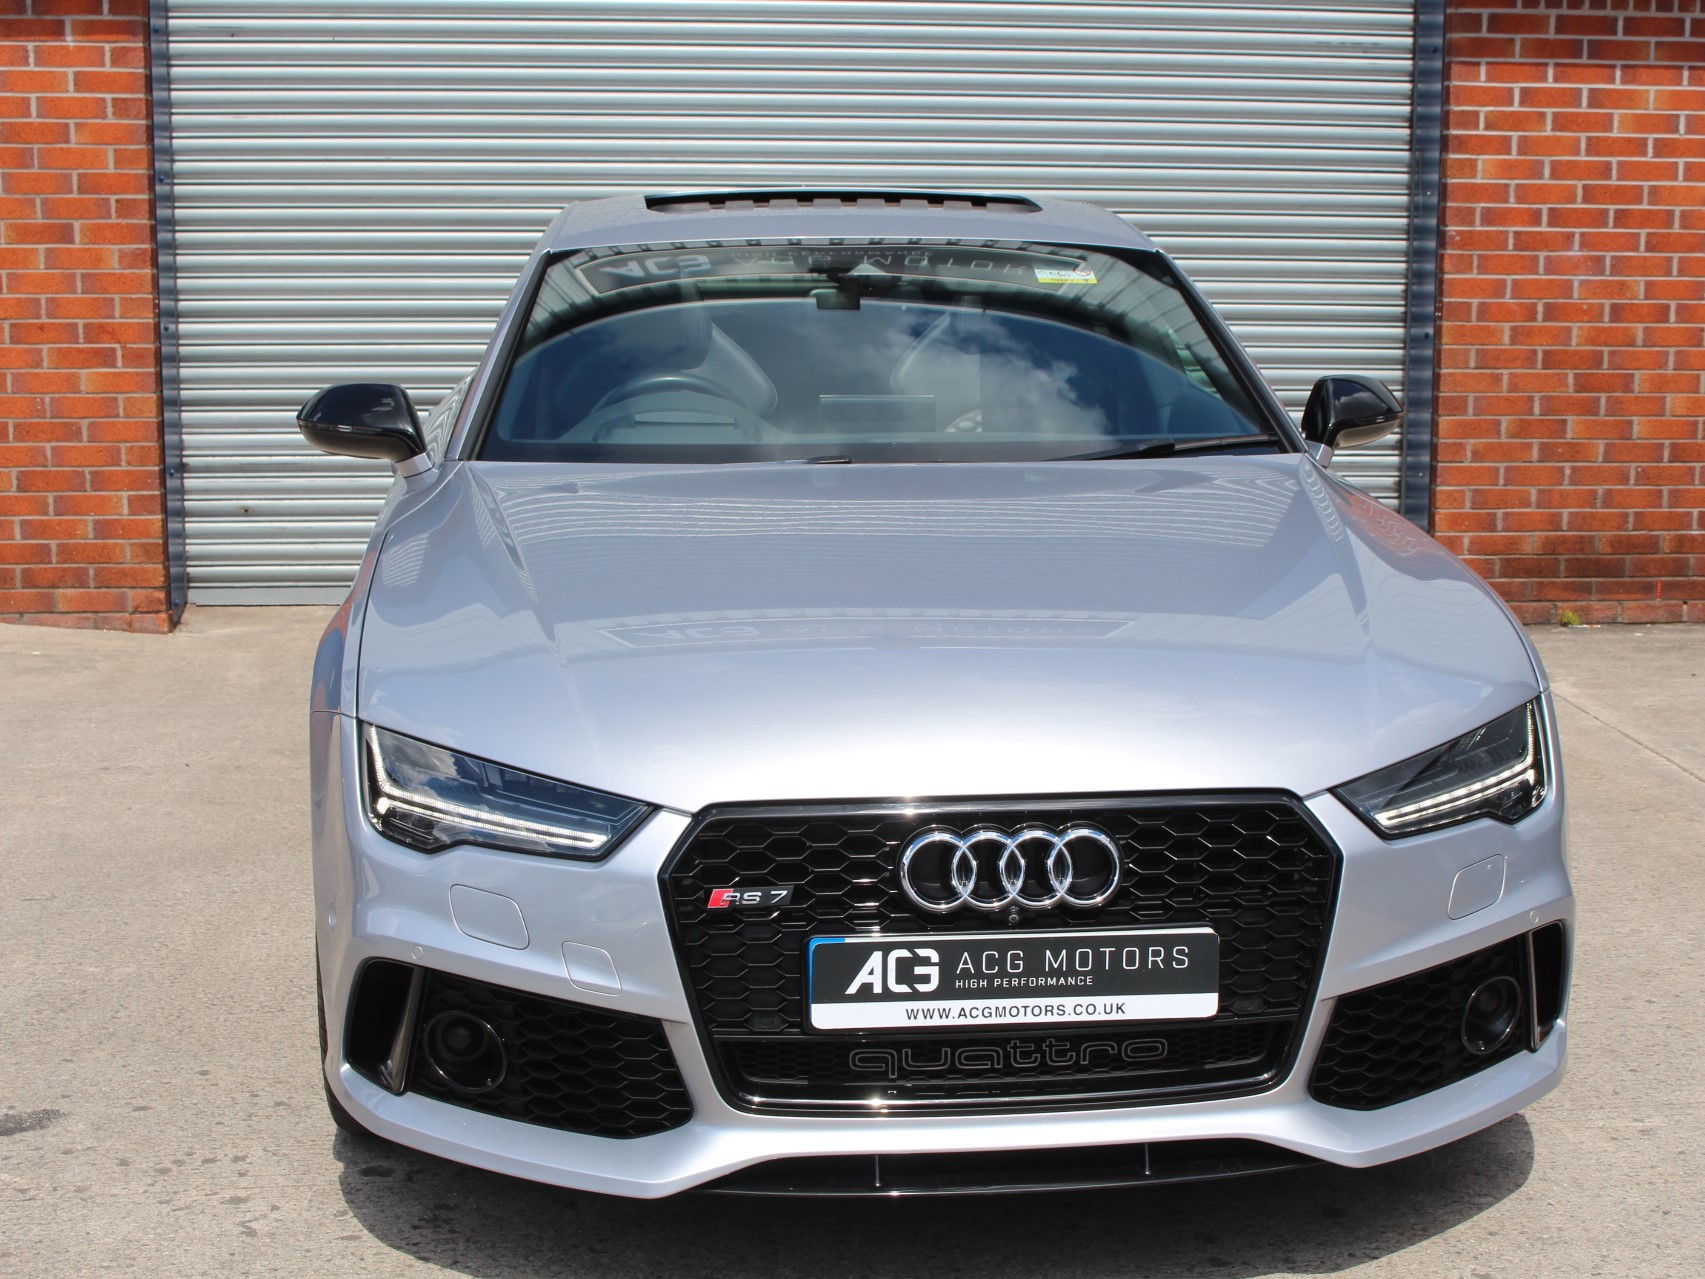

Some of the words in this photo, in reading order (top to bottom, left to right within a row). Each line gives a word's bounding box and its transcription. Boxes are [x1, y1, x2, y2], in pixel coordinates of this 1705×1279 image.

[720, 892, 762, 905] RS
[770, 890, 788, 904] 7
[844, 948, 940, 994] ACG
[956, 949, 1025, 974] ACG
[1044, 946, 1190, 972] MOTORS
[955, 978, 990, 989] HIGH
[994, 976, 1094, 988] PERFORMANCE
[905, 1002, 1127, 1021] WWW.ACGMOTORS.CO.UK
[850, 1038, 1168, 1079] quattro
